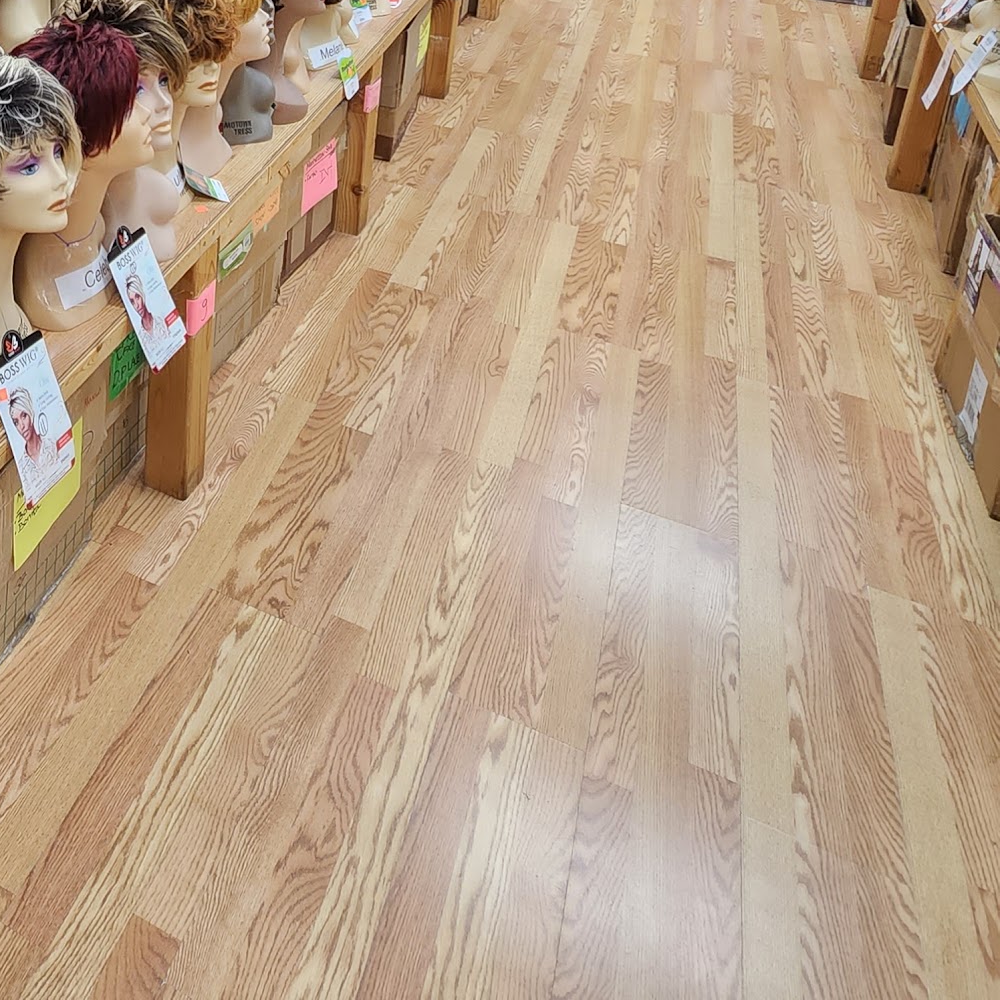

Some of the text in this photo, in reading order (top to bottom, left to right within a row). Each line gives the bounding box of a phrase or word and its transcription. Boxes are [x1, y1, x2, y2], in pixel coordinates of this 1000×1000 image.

[223, 120, 252, 129] MOTOWN
[234, 128, 253, 136] TRESS
[18, 350, 36, 369] WIG
